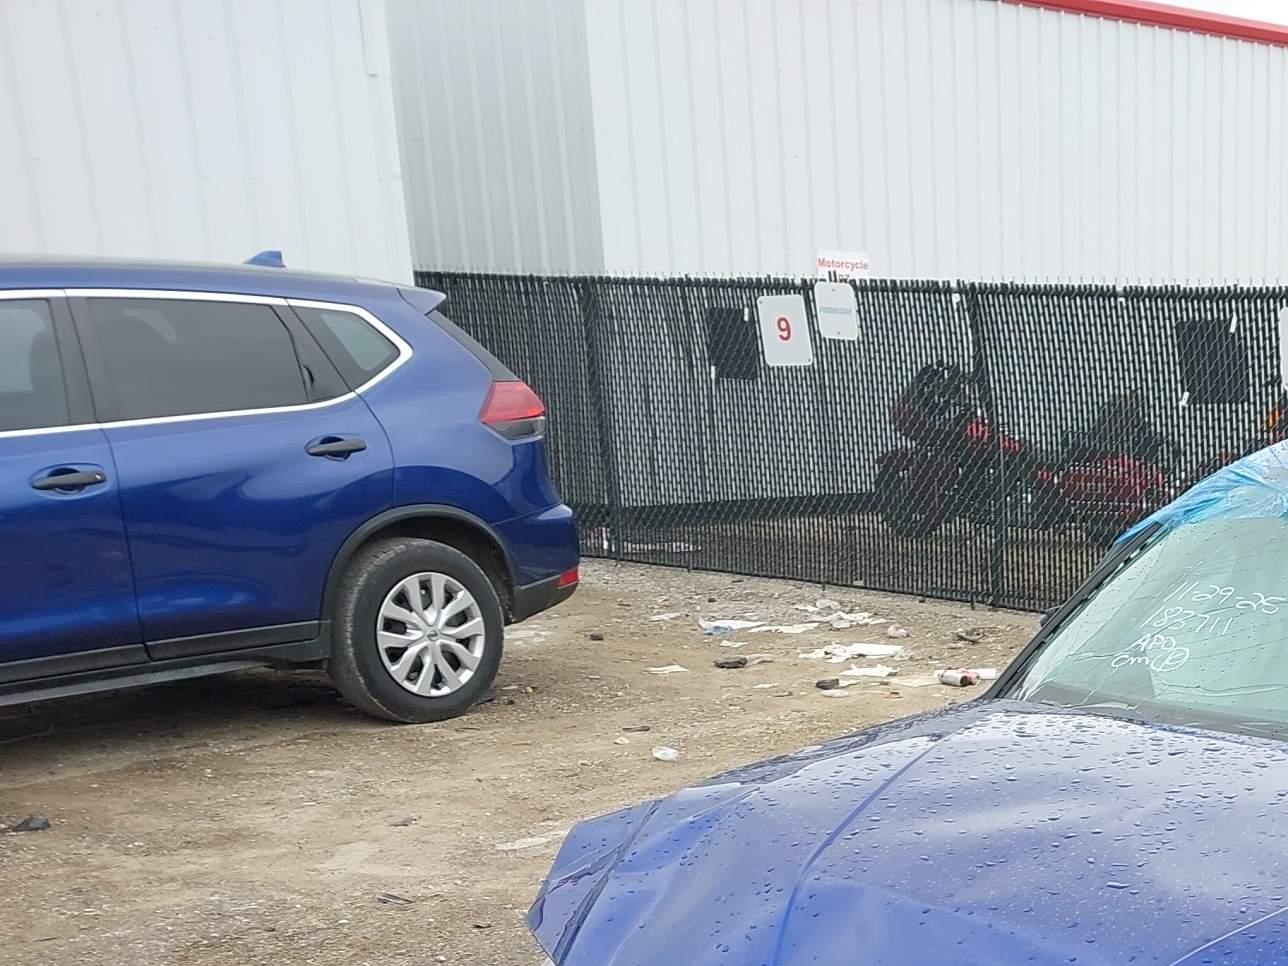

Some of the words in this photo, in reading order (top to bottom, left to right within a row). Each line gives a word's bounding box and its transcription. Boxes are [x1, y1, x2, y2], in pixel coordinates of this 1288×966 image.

[817, 257, 868, 271] Motorcycle
[776, 317, 791, 341] 9
[1163, 581, 1286, 614] 11-29-25
